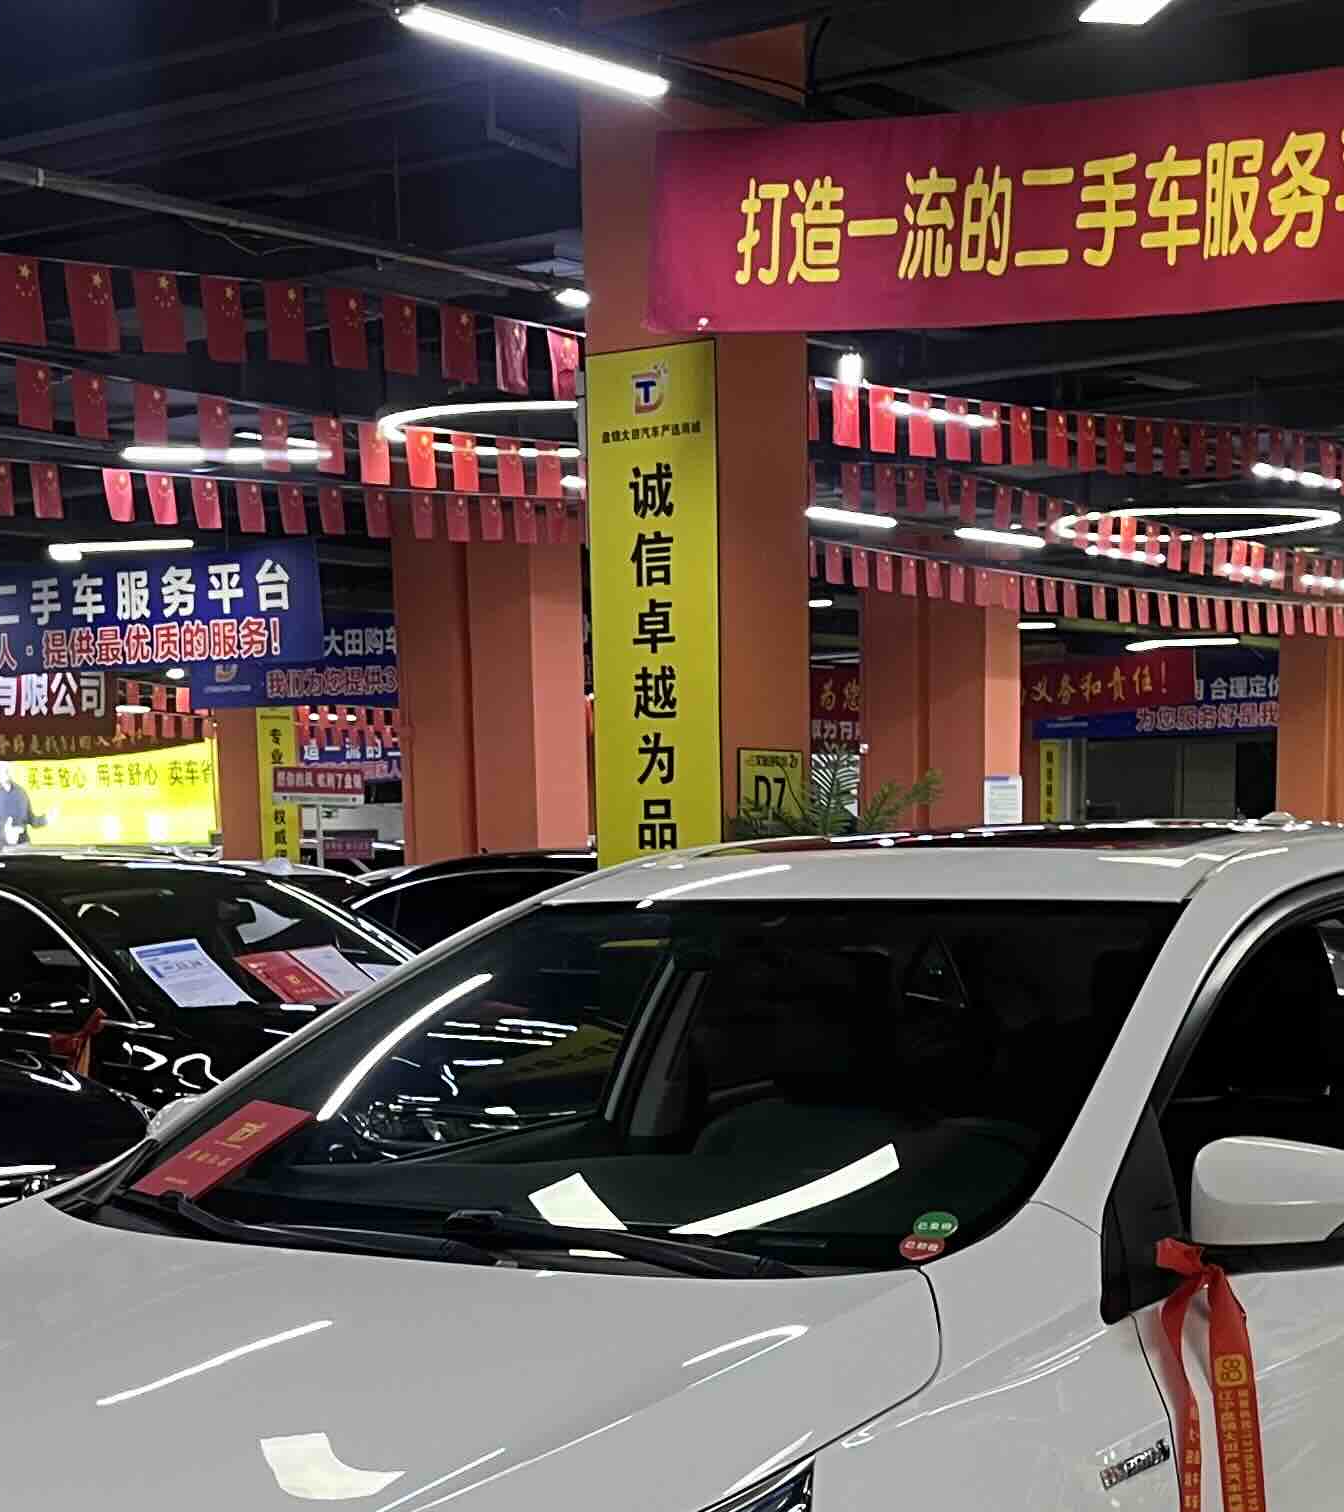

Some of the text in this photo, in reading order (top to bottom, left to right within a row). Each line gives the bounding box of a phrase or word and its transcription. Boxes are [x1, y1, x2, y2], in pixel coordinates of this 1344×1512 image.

[629, 462, 678, 851] 诚信卓越为品
